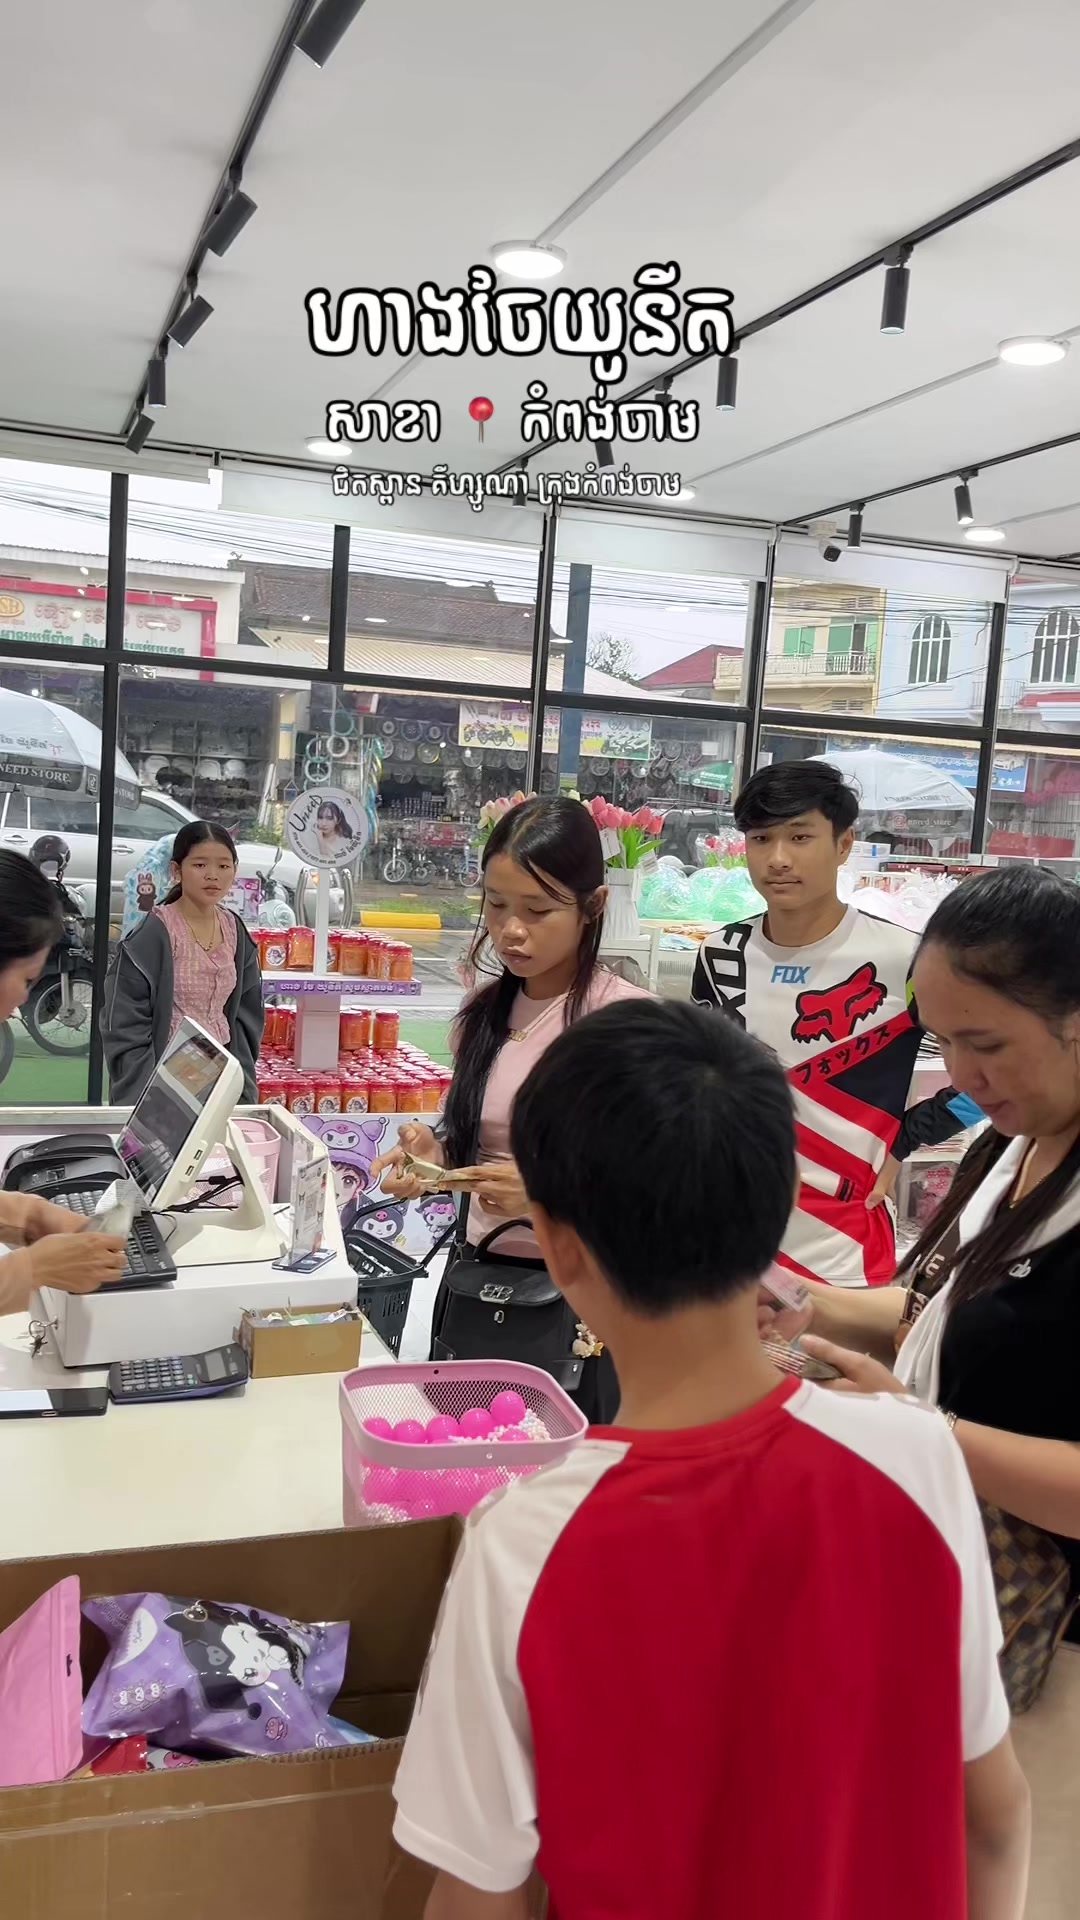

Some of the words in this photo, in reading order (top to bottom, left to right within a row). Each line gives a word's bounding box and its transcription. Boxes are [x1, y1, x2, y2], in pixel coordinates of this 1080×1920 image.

[31, 767, 71, 783] STORE
[771, 965, 811, 984] FOX
[795, 1024, 891, 1085] フォックス
